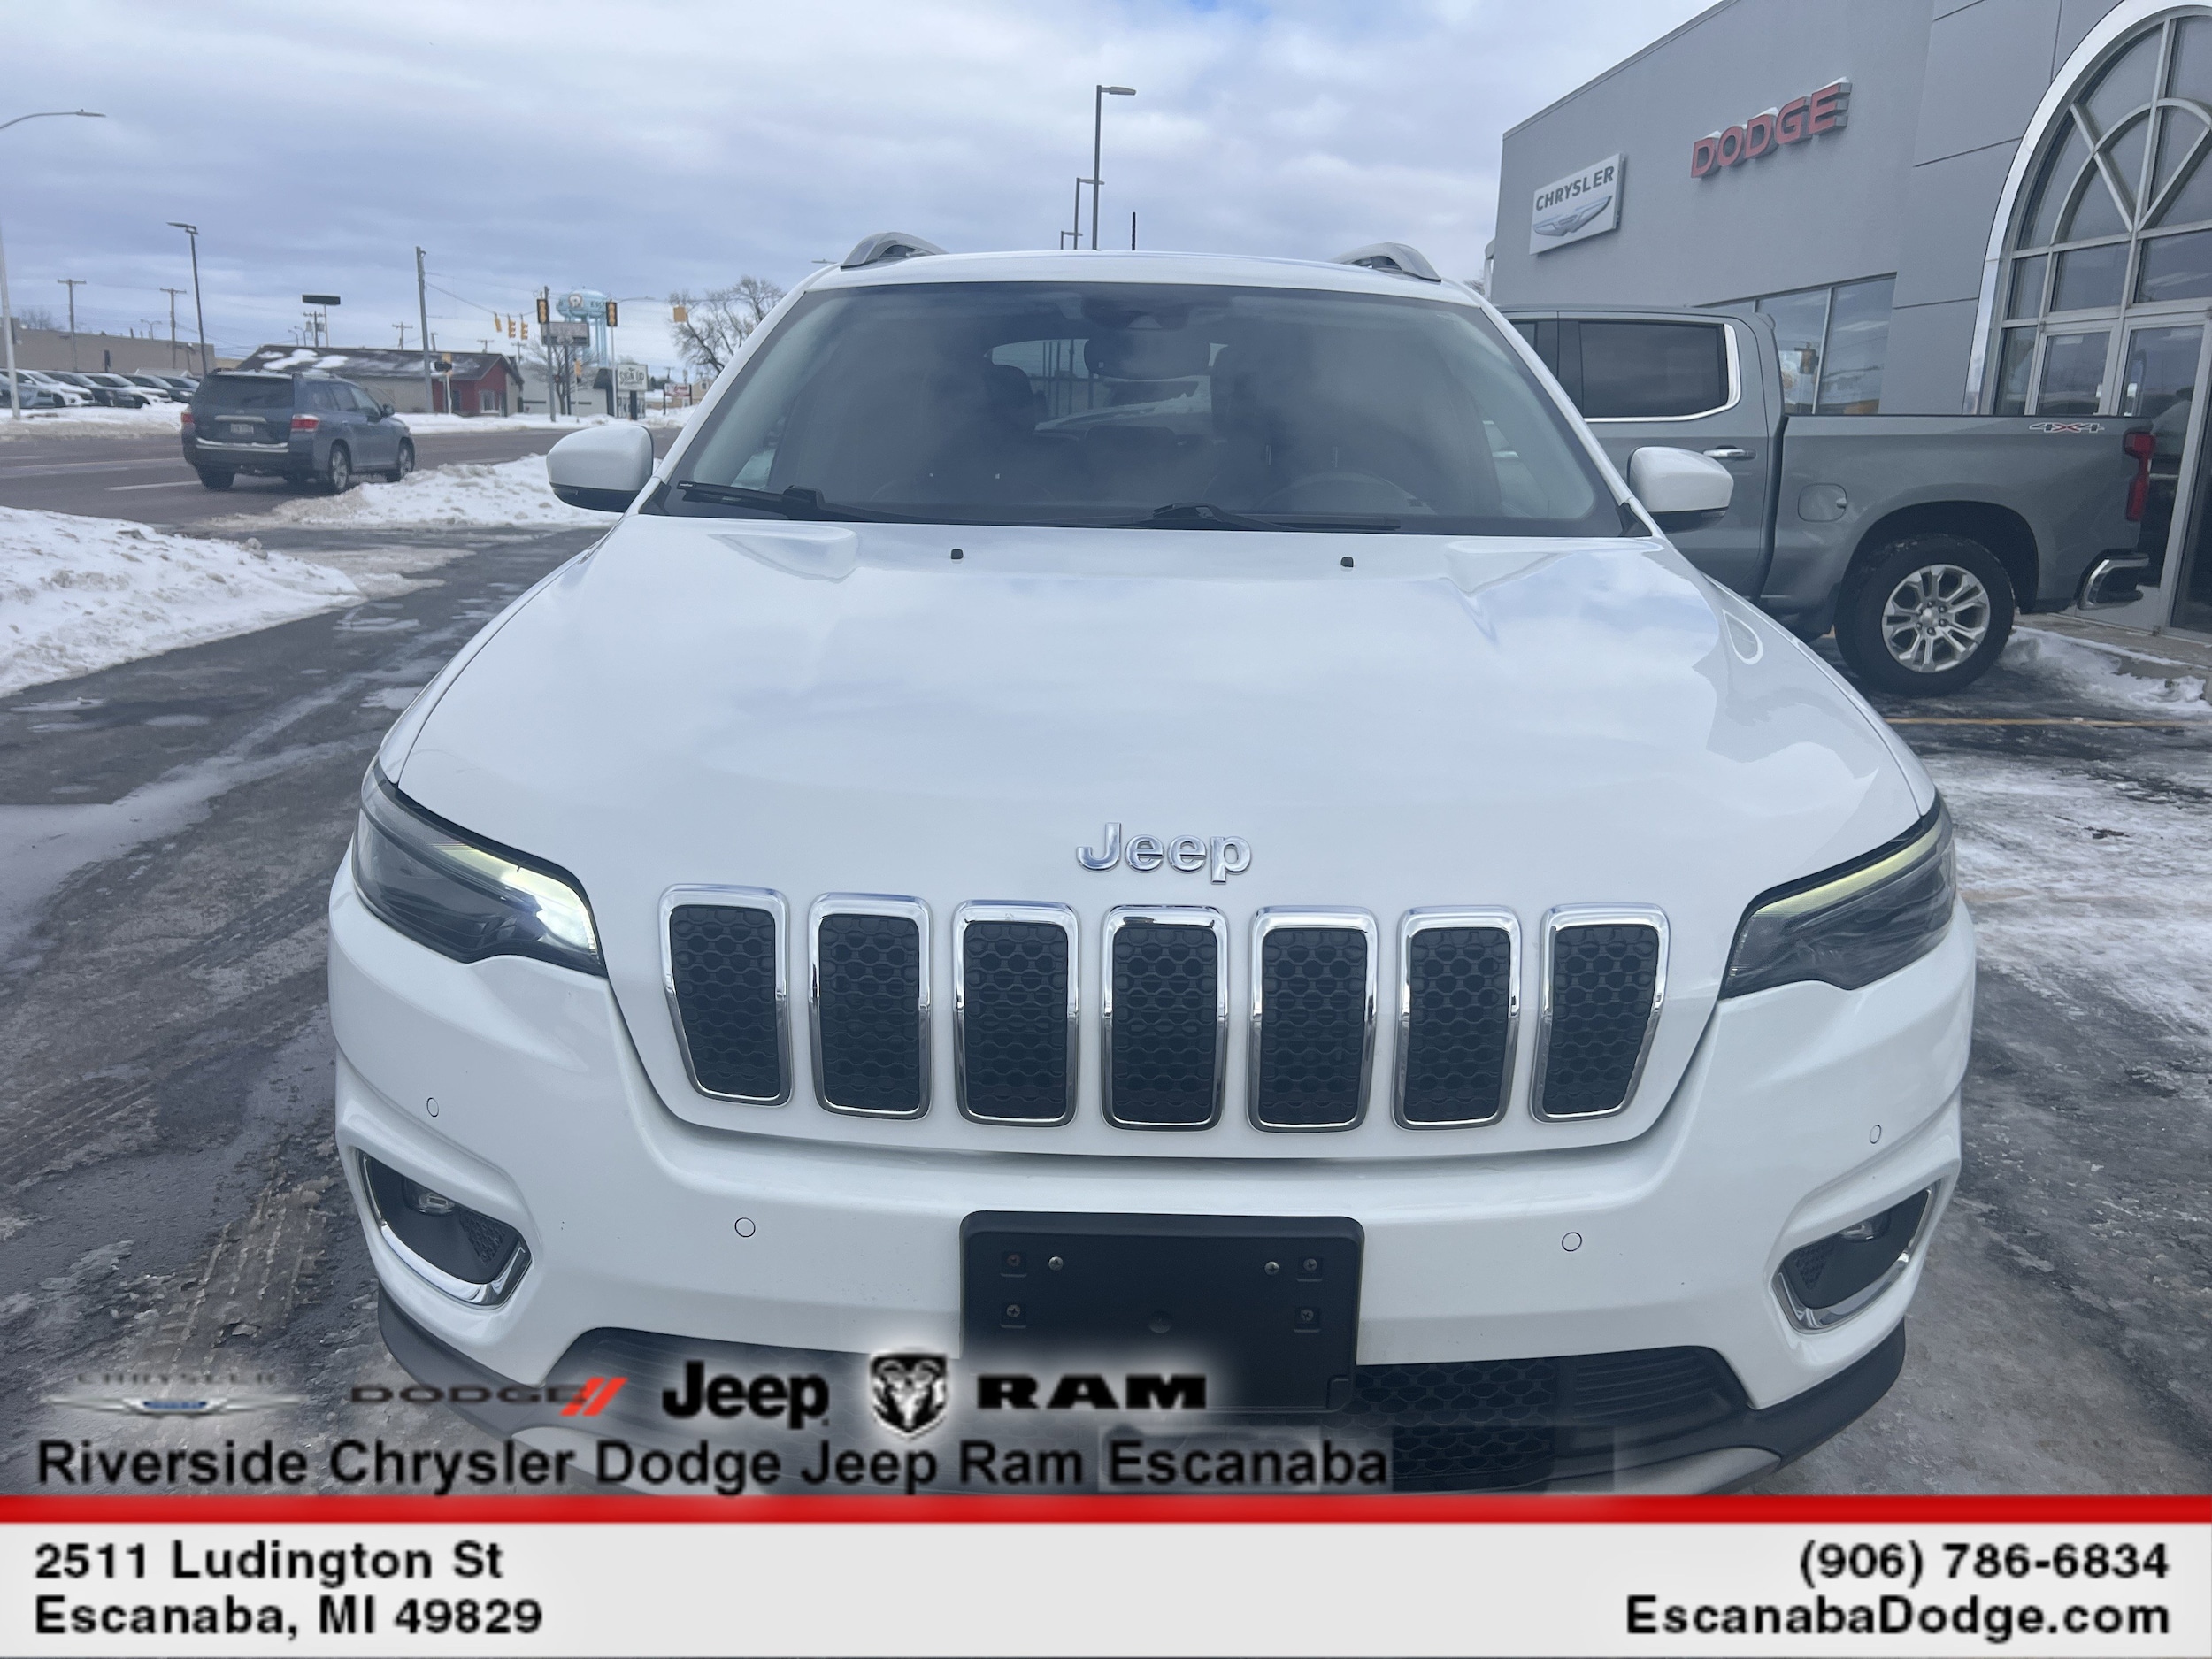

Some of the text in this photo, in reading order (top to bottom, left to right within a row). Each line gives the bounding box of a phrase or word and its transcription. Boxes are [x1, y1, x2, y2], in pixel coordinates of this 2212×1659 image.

[1691, 81, 1851, 178] DODGE
[1536, 165, 1615, 212] CHRYSLER
[1076, 822, 1252, 885] Jeep
